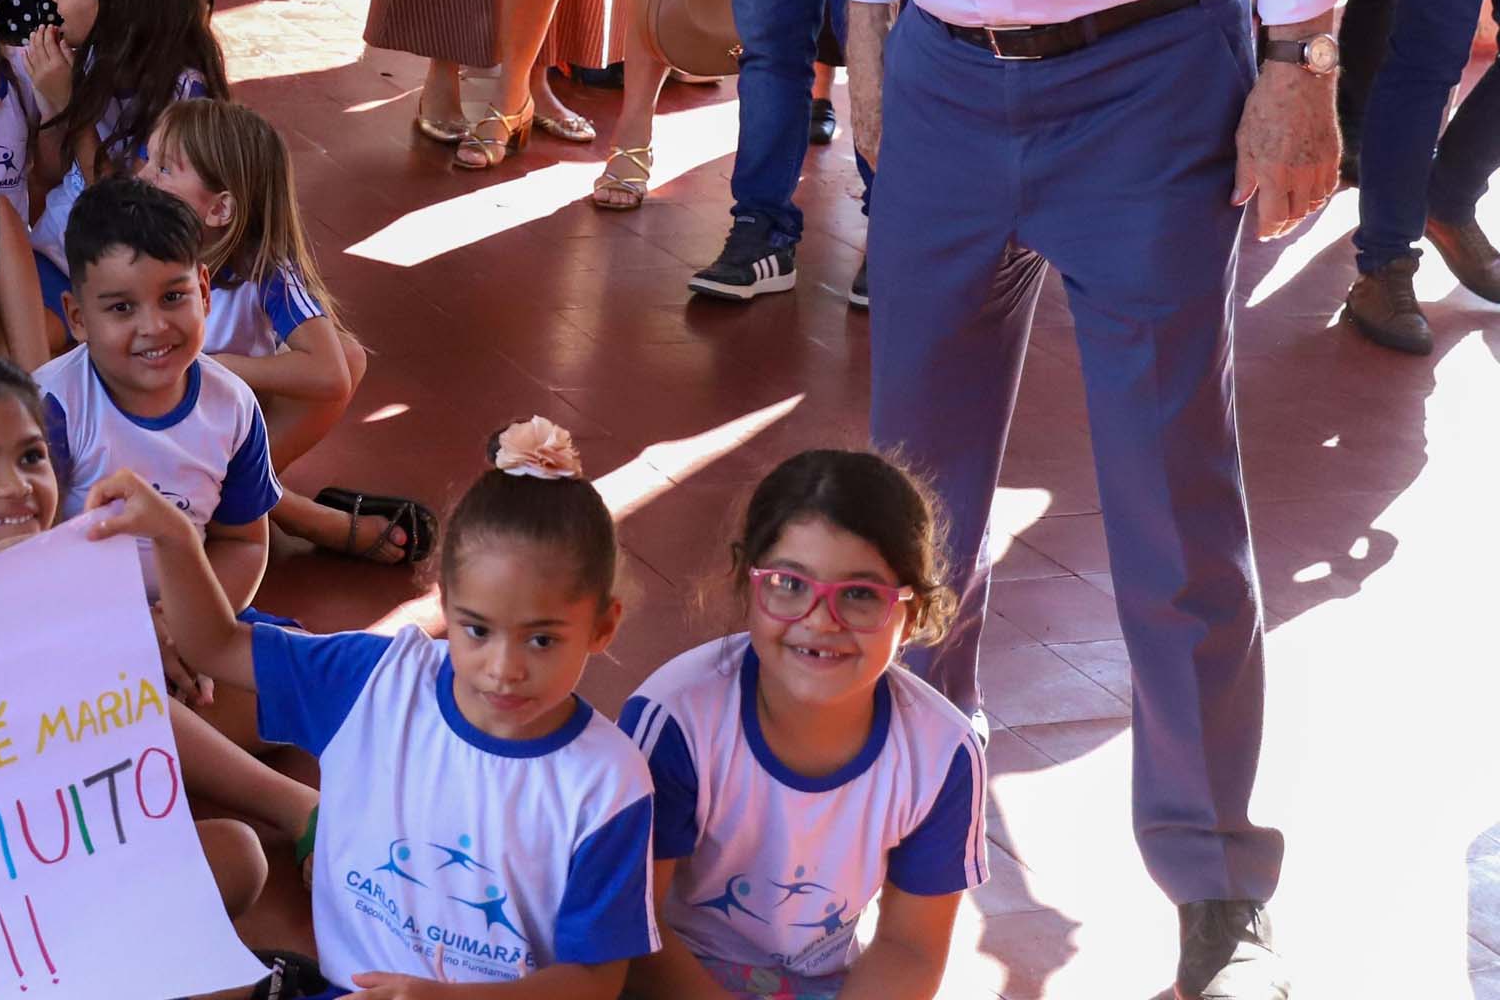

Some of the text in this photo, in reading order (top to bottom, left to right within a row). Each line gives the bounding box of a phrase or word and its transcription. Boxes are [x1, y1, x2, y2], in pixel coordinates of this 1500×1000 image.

[346, 870, 400, 918] CARLO
[403, 915, 420, 935] A.
[427, 926, 536, 967] GUIMARÃE
